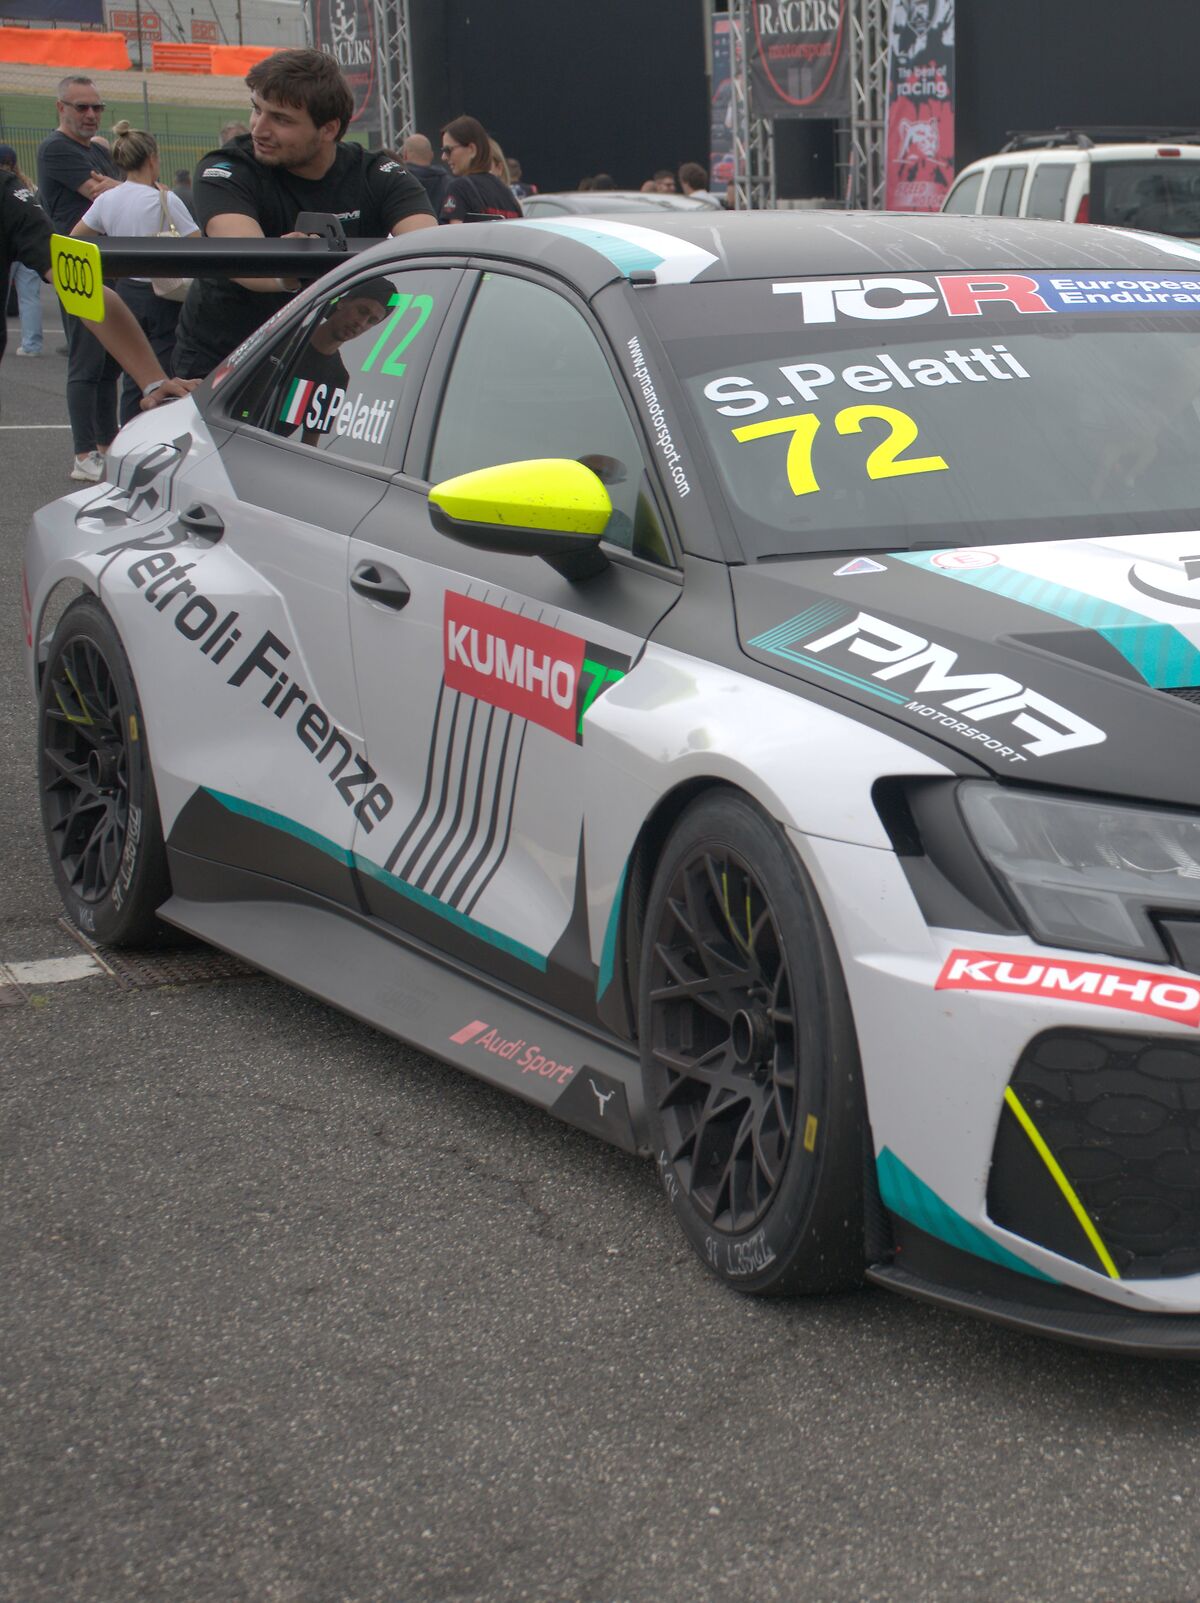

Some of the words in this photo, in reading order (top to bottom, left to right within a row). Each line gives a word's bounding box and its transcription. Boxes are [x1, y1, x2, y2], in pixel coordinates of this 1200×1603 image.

[759, 0, 840, 34] RACERS
[897, 78, 948, 98] racing
[772, 274, 1056, 324] TCR
[362, 293, 434, 377] 72
[305, 383, 394, 444] S.Pelatti
[704, 345, 1031, 417] S.Pelatti
[626, 336, 691, 499] www.pmamotorsport.com
[731, 404, 949, 496] 72
[447, 619, 576, 710] KUMHO
[227, 630, 393, 834] Firenze
[904, 700, 1027, 764] MOTORSPORT
[475, 1028, 521, 1062] Audi
[517, 1045, 575, 1085] Sport
